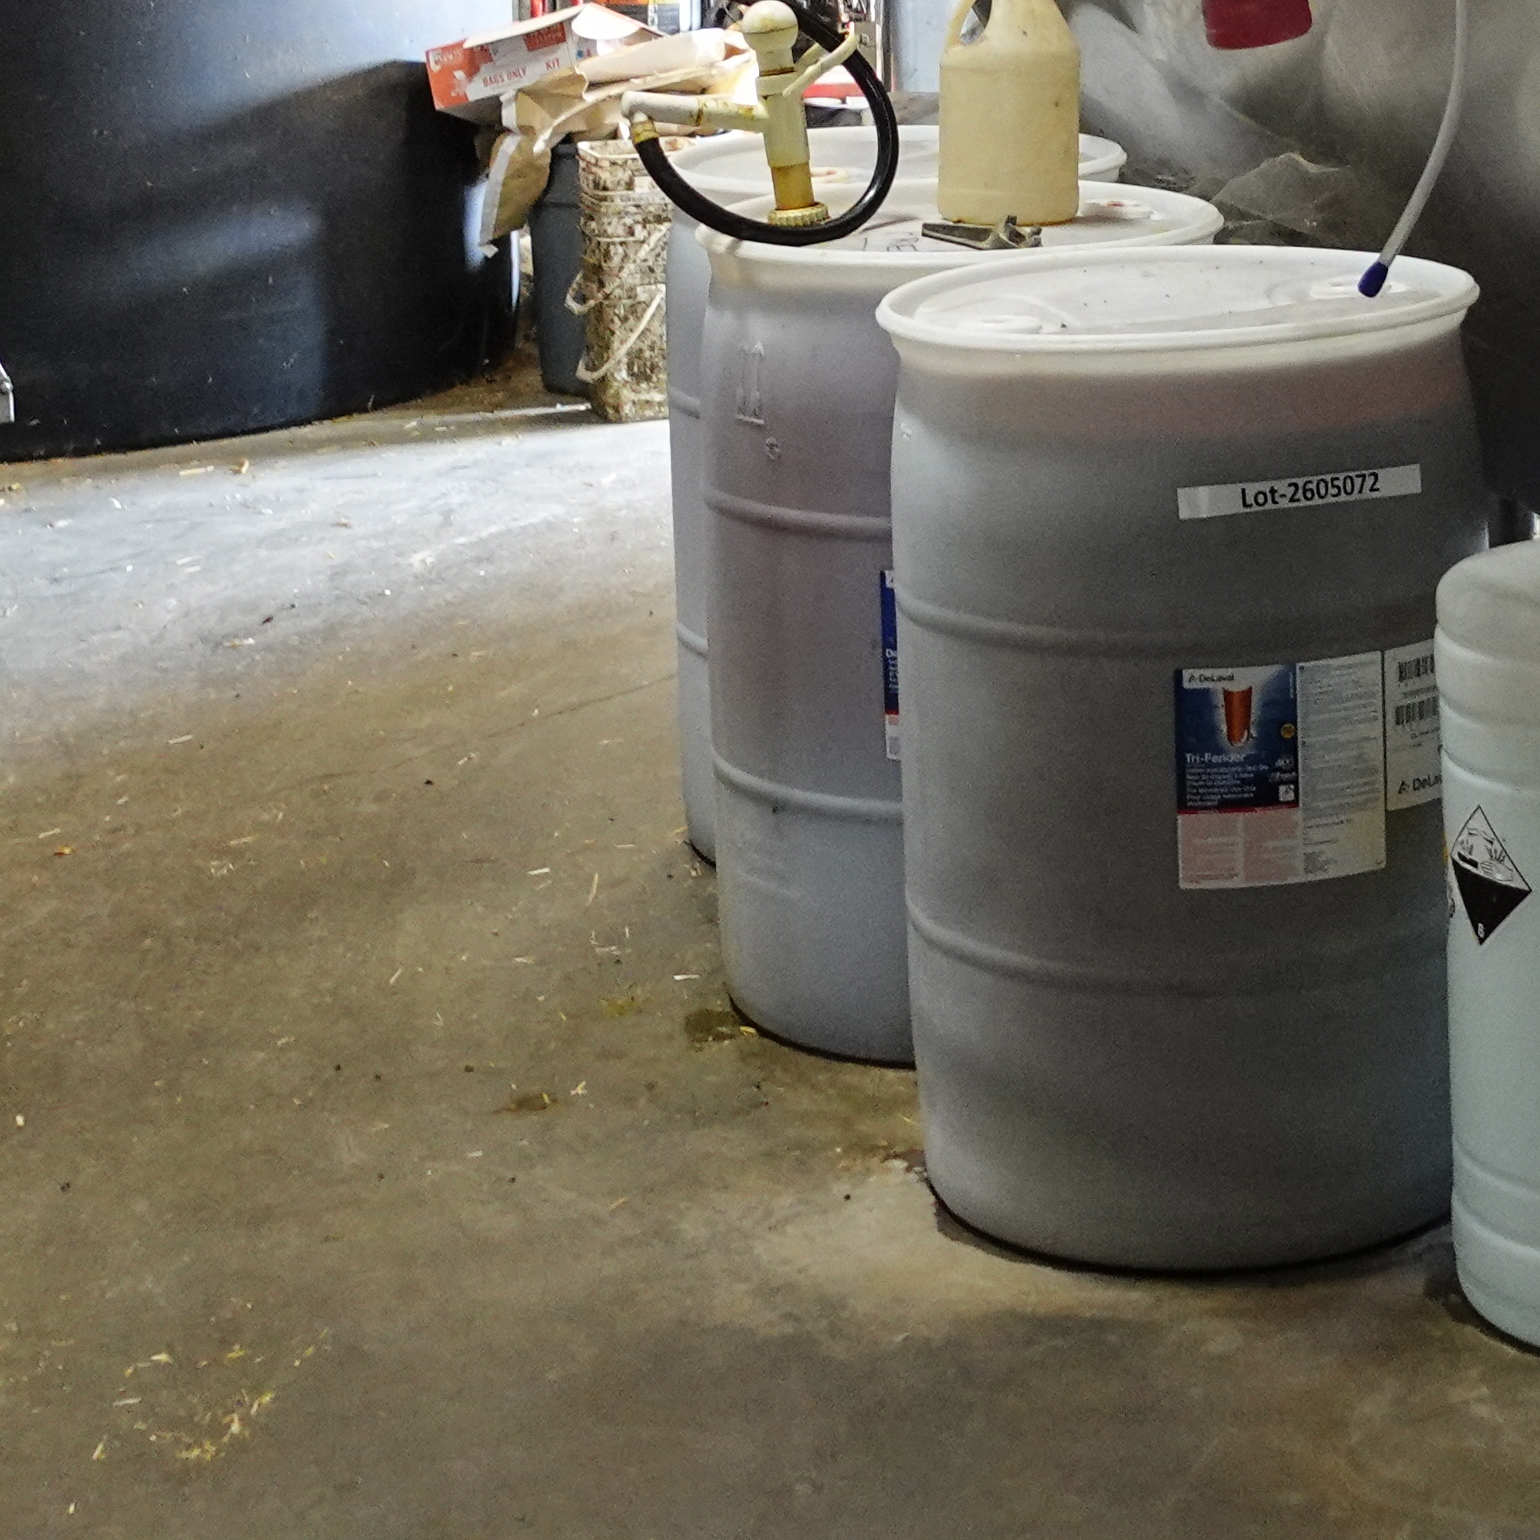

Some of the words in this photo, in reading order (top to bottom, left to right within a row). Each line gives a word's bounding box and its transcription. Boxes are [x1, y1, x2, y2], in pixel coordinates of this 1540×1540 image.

[483, 73, 504, 88] BAGS
[506, 66, 527, 82] ONLY
[545, 58, 561, 71] KIT
[1240, 472, 1380, 509] Lot-2605072
[1199, 673, 1235, 683] DeLaval
[1412, 774, 1442, 791] DeLa
